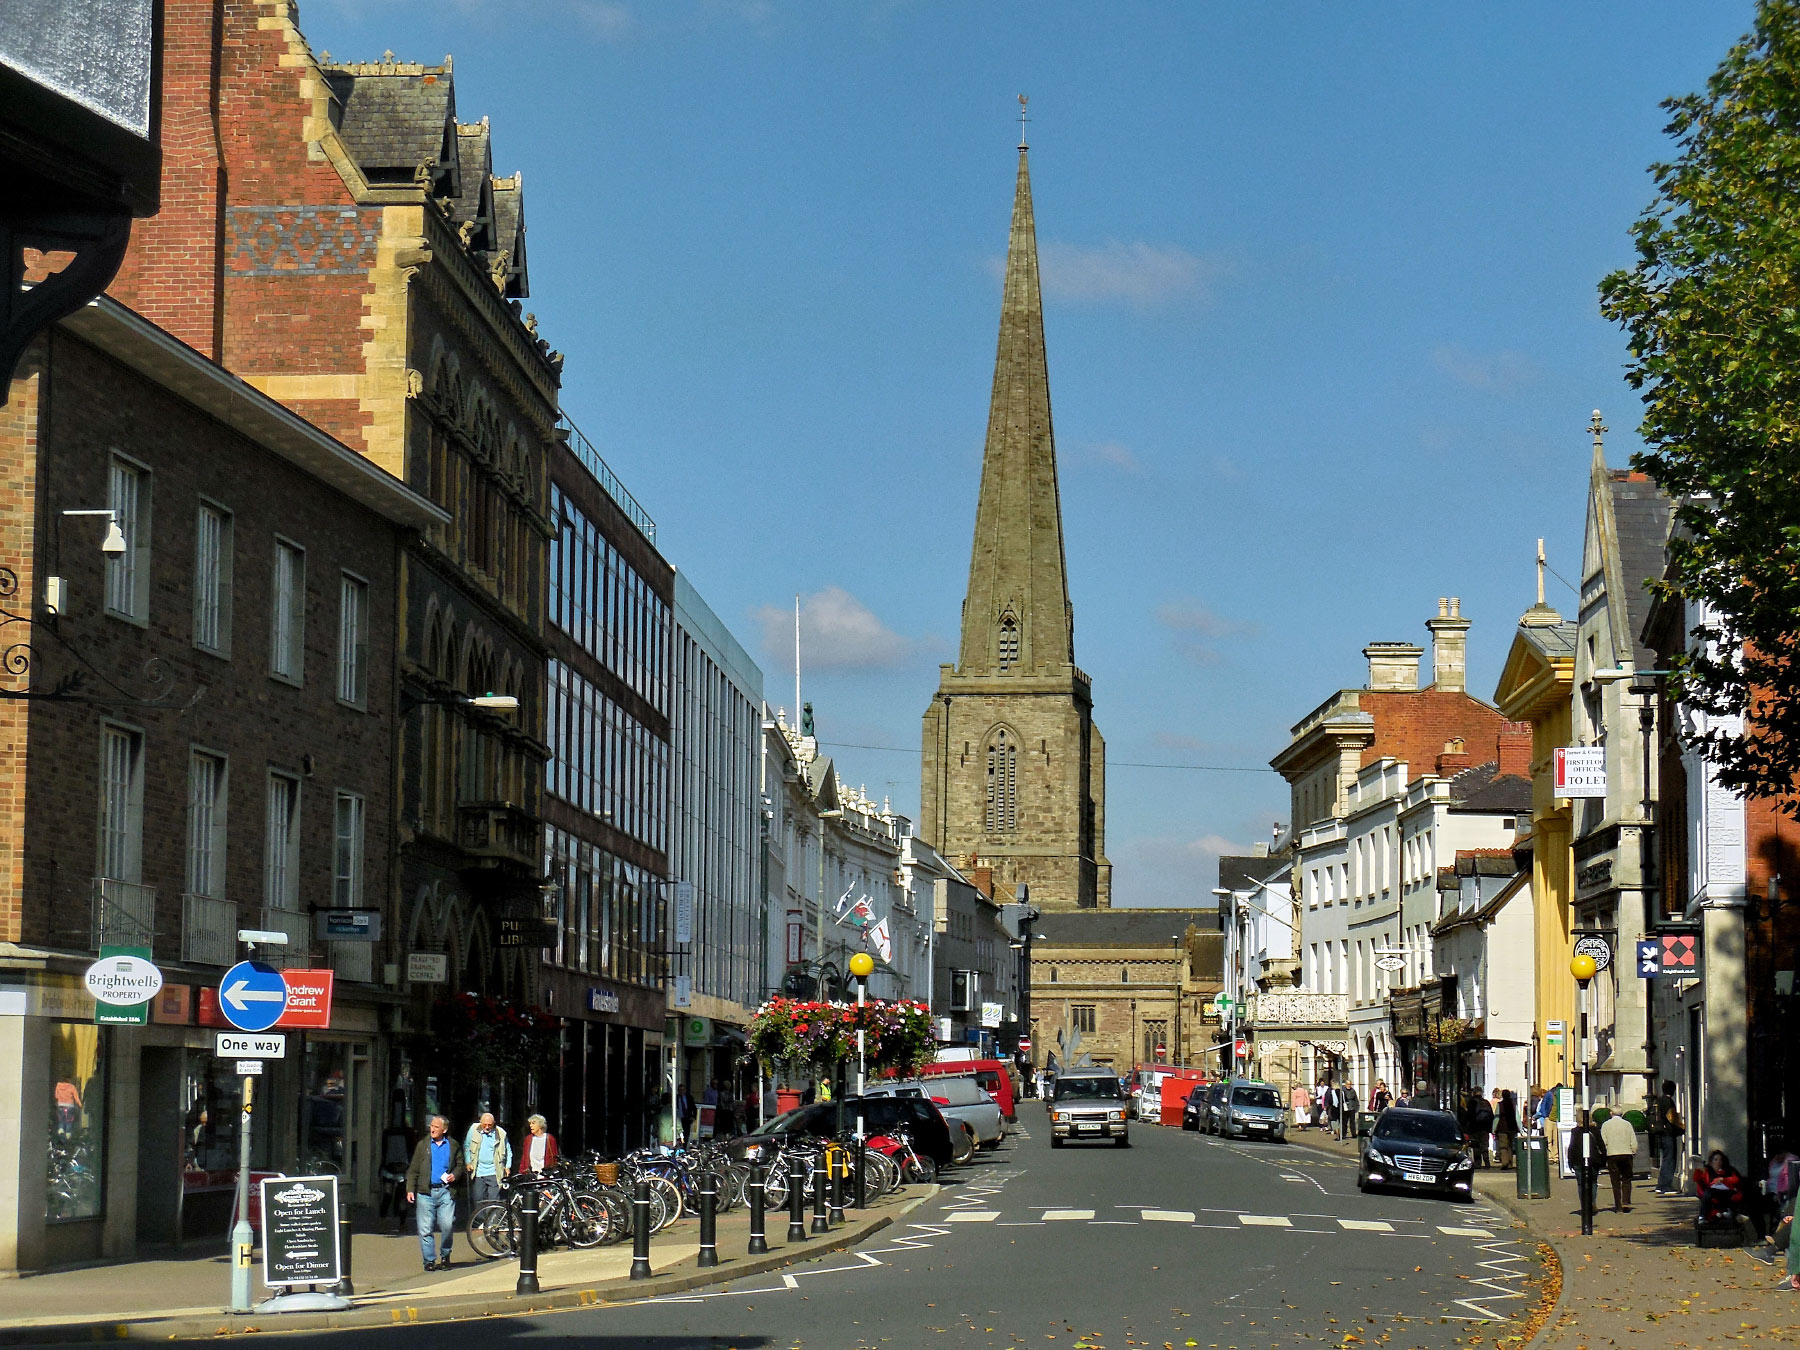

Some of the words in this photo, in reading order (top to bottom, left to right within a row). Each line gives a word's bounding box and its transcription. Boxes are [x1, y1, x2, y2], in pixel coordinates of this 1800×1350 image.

[1568, 776, 1583, 785] TO
[1586, 776, 1606, 785] LET
[89, 974, 159, 989] Brightwells
[102, 990, 143, 999] PROPERTY
[285, 984, 324, 996] Andrew
[287, 995, 316, 1006] Grant
[221, 1039, 249, 1051] One
[254, 1041, 281, 1053] way
[274, 1209, 293, 1218] Open
[305, 1207, 326, 1215] Lunch
[240, 1245, 254, 1265] H
[274, 1263, 294, 1272] Open
[306, 1261, 330, 1269] Dinner
